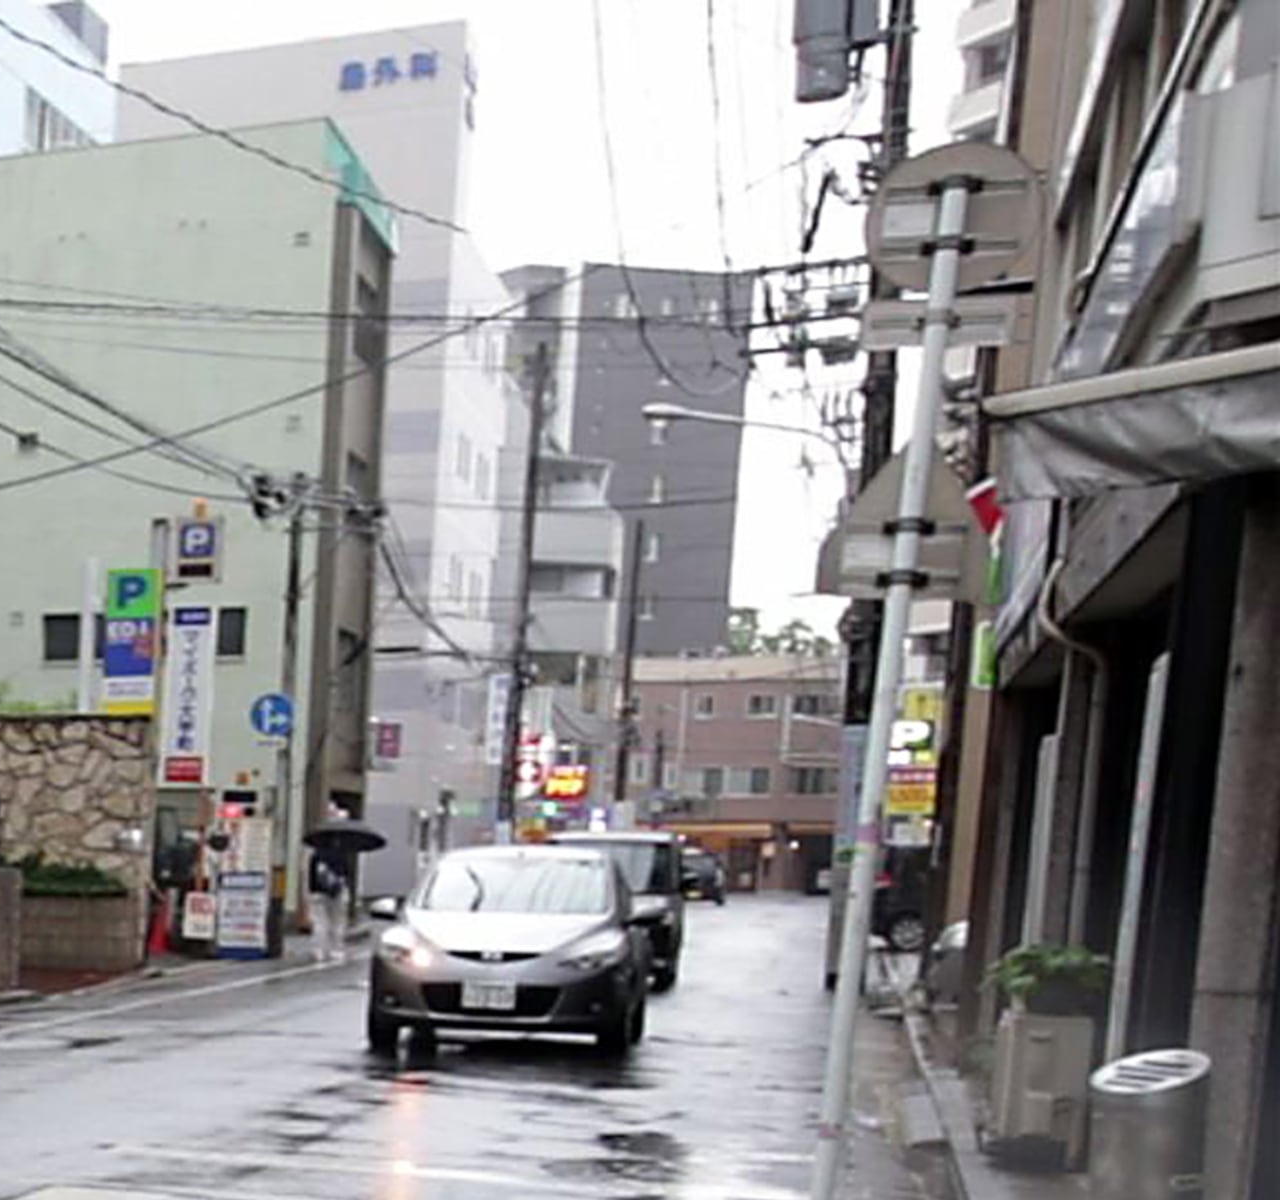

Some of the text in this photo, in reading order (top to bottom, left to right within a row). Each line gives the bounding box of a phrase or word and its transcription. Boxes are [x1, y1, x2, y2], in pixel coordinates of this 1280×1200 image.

[186, 528, 210, 554] P
[116, 575, 147, 610] P
[890, 720, 931, 749] P
